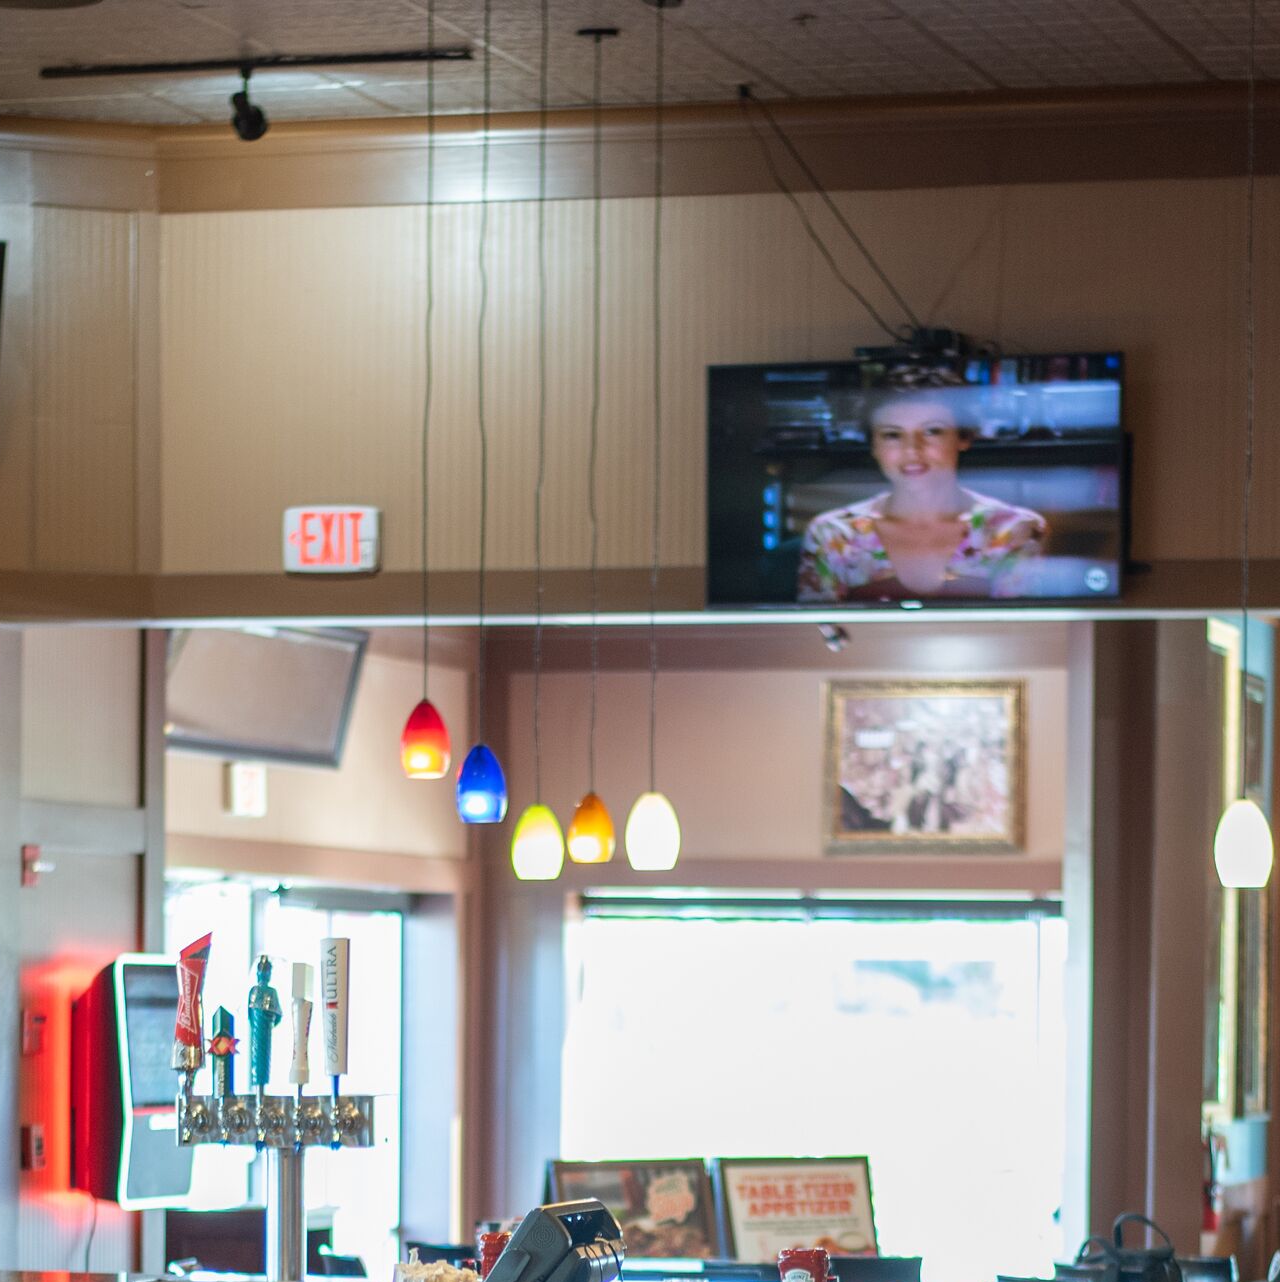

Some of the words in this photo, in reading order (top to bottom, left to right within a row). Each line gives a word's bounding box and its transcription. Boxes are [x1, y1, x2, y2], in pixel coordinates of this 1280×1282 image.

[300, 512, 364, 565] EXIT
[181, 968, 193, 1027] Budweiser
[326, 945, 337, 1000] ULTRA
[326, 1012, 338, 1063] Michelob
[736, 1182, 856, 1200] TABLE-TIZER
[748, 1200, 851, 1217] APPETIZER
